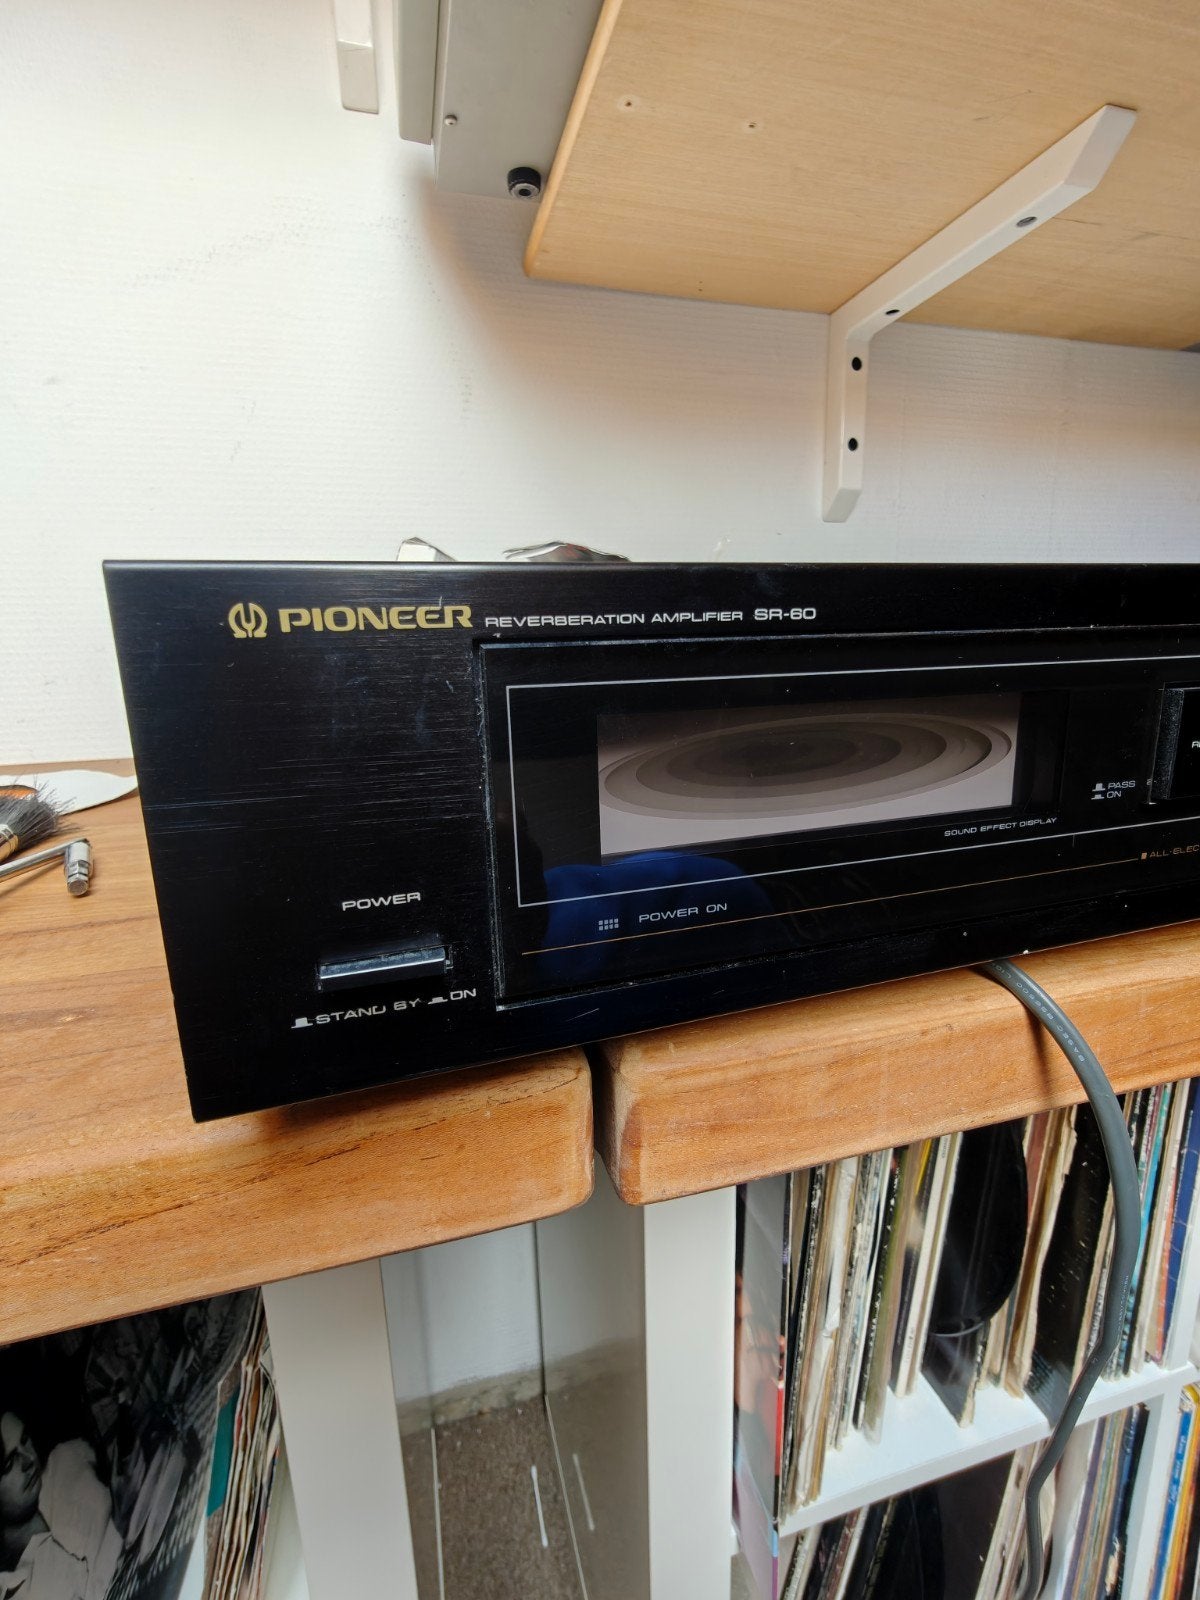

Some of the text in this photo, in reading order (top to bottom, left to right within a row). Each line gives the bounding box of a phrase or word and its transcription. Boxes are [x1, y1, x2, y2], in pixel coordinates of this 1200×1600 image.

[278, 604, 474, 634] PIONEER
[484, 607, 818, 628] REVERBERATION AMPLIFIER SR-60
[1106, 790, 1122, 799] ON
[1107, 780, 1136, 790] PASS
[944, 817, 1057, 837] SOUND EFFECT DISPLAY
[341, 891, 421, 912] POWER
[638, 902, 728, 924] POWER ON
[314, 988, 478, 1025] STAND BY ON
